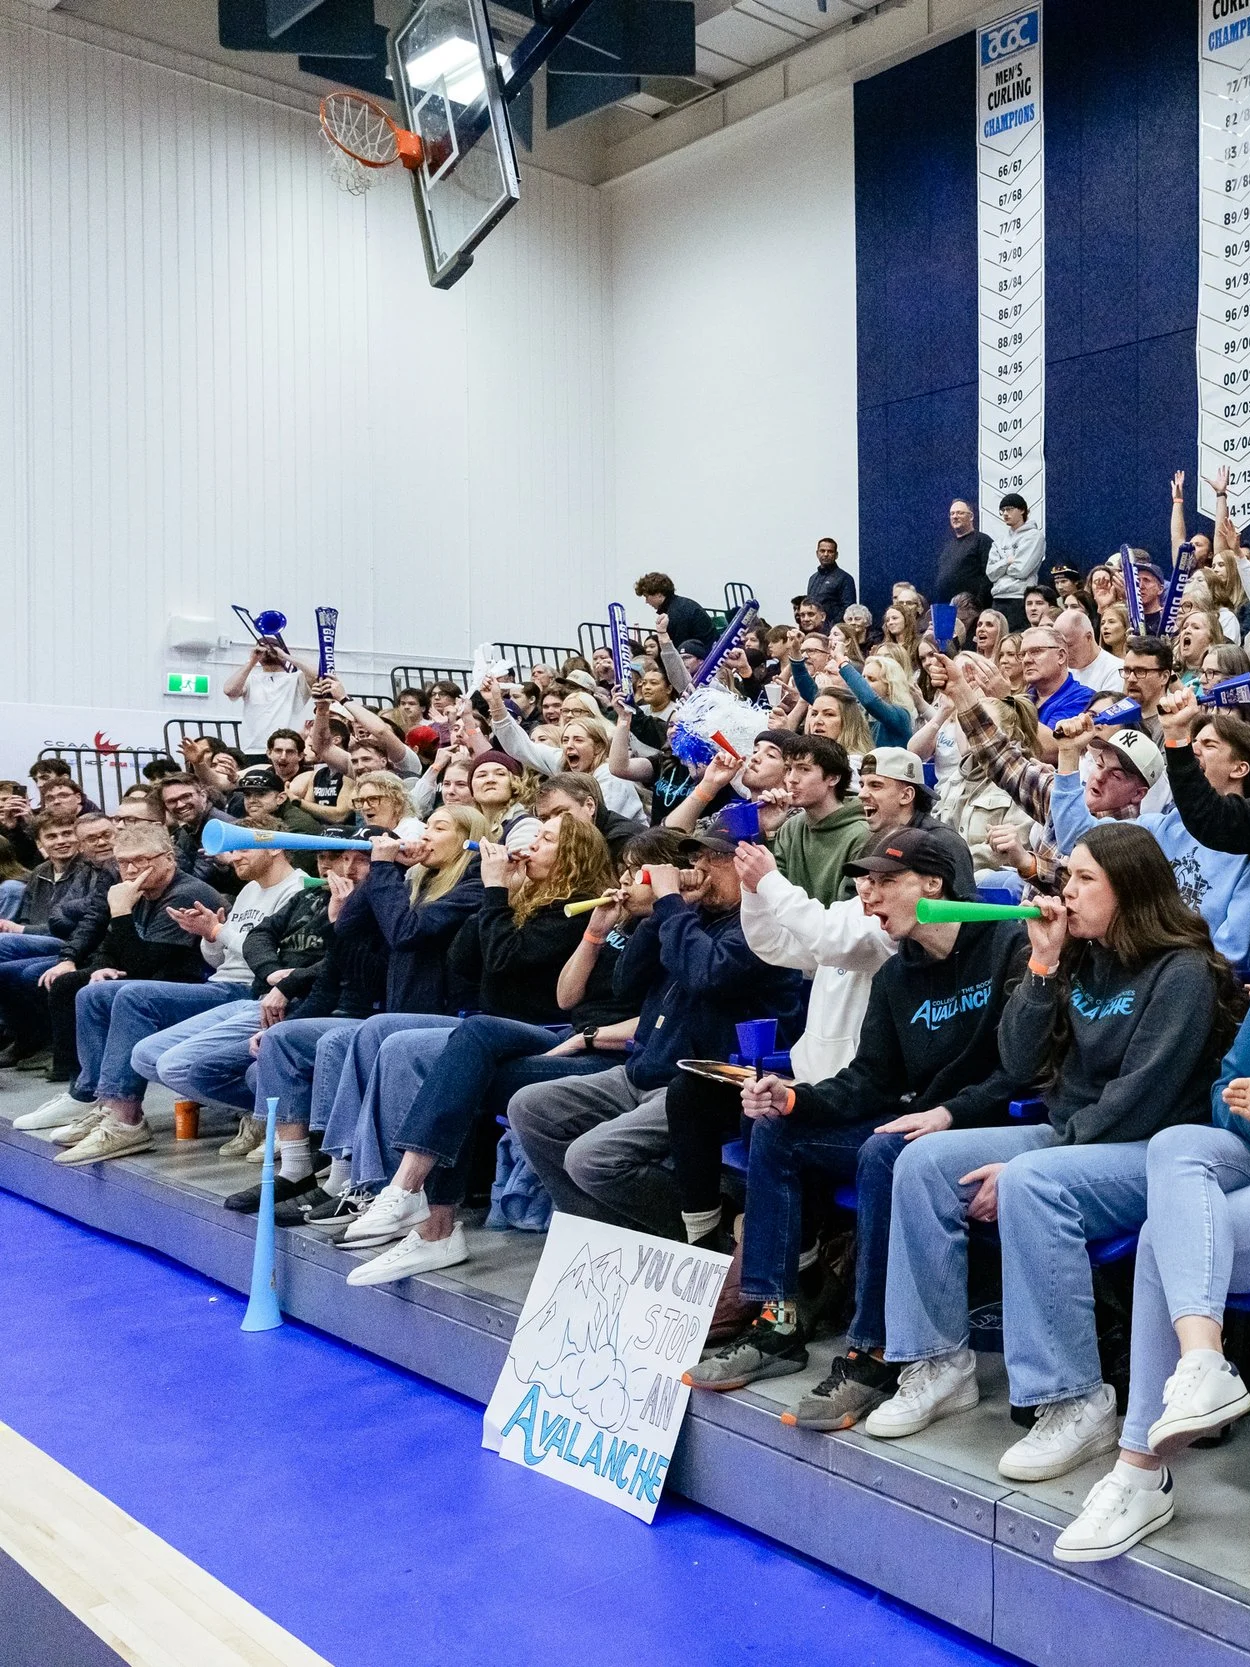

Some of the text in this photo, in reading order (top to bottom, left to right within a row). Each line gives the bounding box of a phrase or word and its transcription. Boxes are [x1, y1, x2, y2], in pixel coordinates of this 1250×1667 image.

[995, 62, 1023, 87] MEN'S
[987, 77, 1032, 112] CURLING
[983, 103, 1035, 139] CHAMPIONS
[998, 159, 1022, 178] 66/67
[998, 188, 1022, 207] 67/68
[999, 217, 1022, 235] 77/78
[998, 246, 1022, 264] 79/80
[998, 275, 1022, 292] 83/84
[998, 303, 1022, 321] 86/87
[997, 332, 1023, 349] 88/89
[997, 361, 1023, 377] 94/95
[997, 389, 1023, 405] 99/00
[998, 417, 1023, 433] 00/01
[998, 446, 1023, 462] 03/04
[998, 474, 1023, 489] 05/06
[1176, 574, 1189, 592] GO
[1165, 597, 1182, 633] OOKS
[630, 1244, 728, 1308] YOU CAN'T
[633, 1303, 701, 1364] STOP
[640, 1373, 683, 1431] AN
[500, 1383, 670, 1504] AVALANCHE
